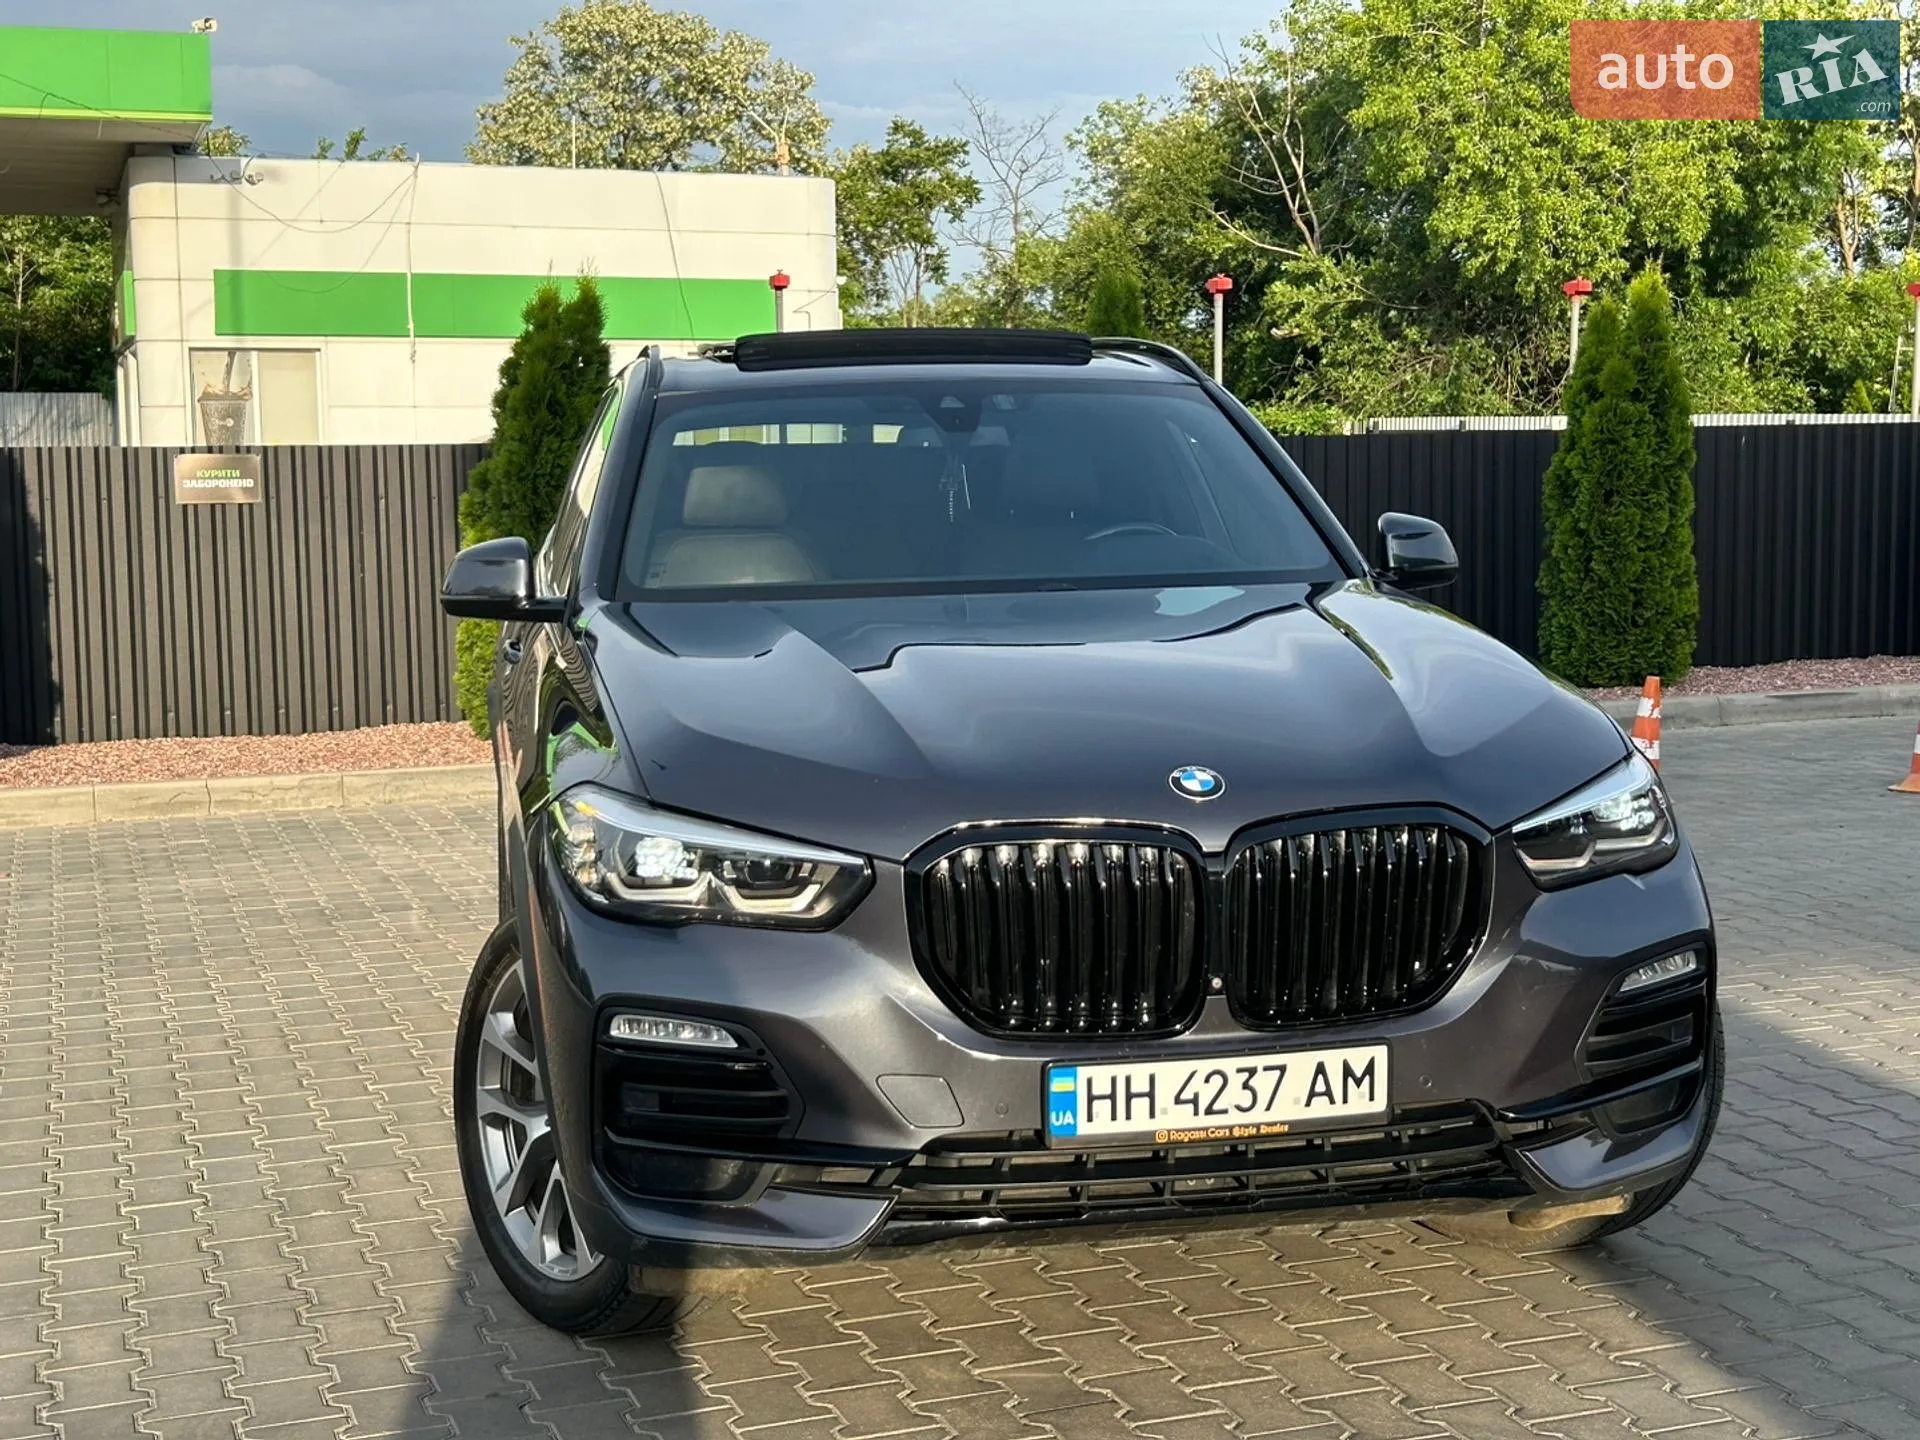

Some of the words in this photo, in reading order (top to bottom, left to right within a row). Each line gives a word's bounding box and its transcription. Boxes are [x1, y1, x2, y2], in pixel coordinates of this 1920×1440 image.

[197, 469, 240, 478] КУРИТИ
[183, 478, 254, 488] ЗАБОРОНЕНО
[1086, 1072, 1156, 1123] HH
[1173, 1064, 1288, 1117] 4237
[1304, 1055, 1376, 1108] AM
[1052, 1110, 1075, 1126] UA
